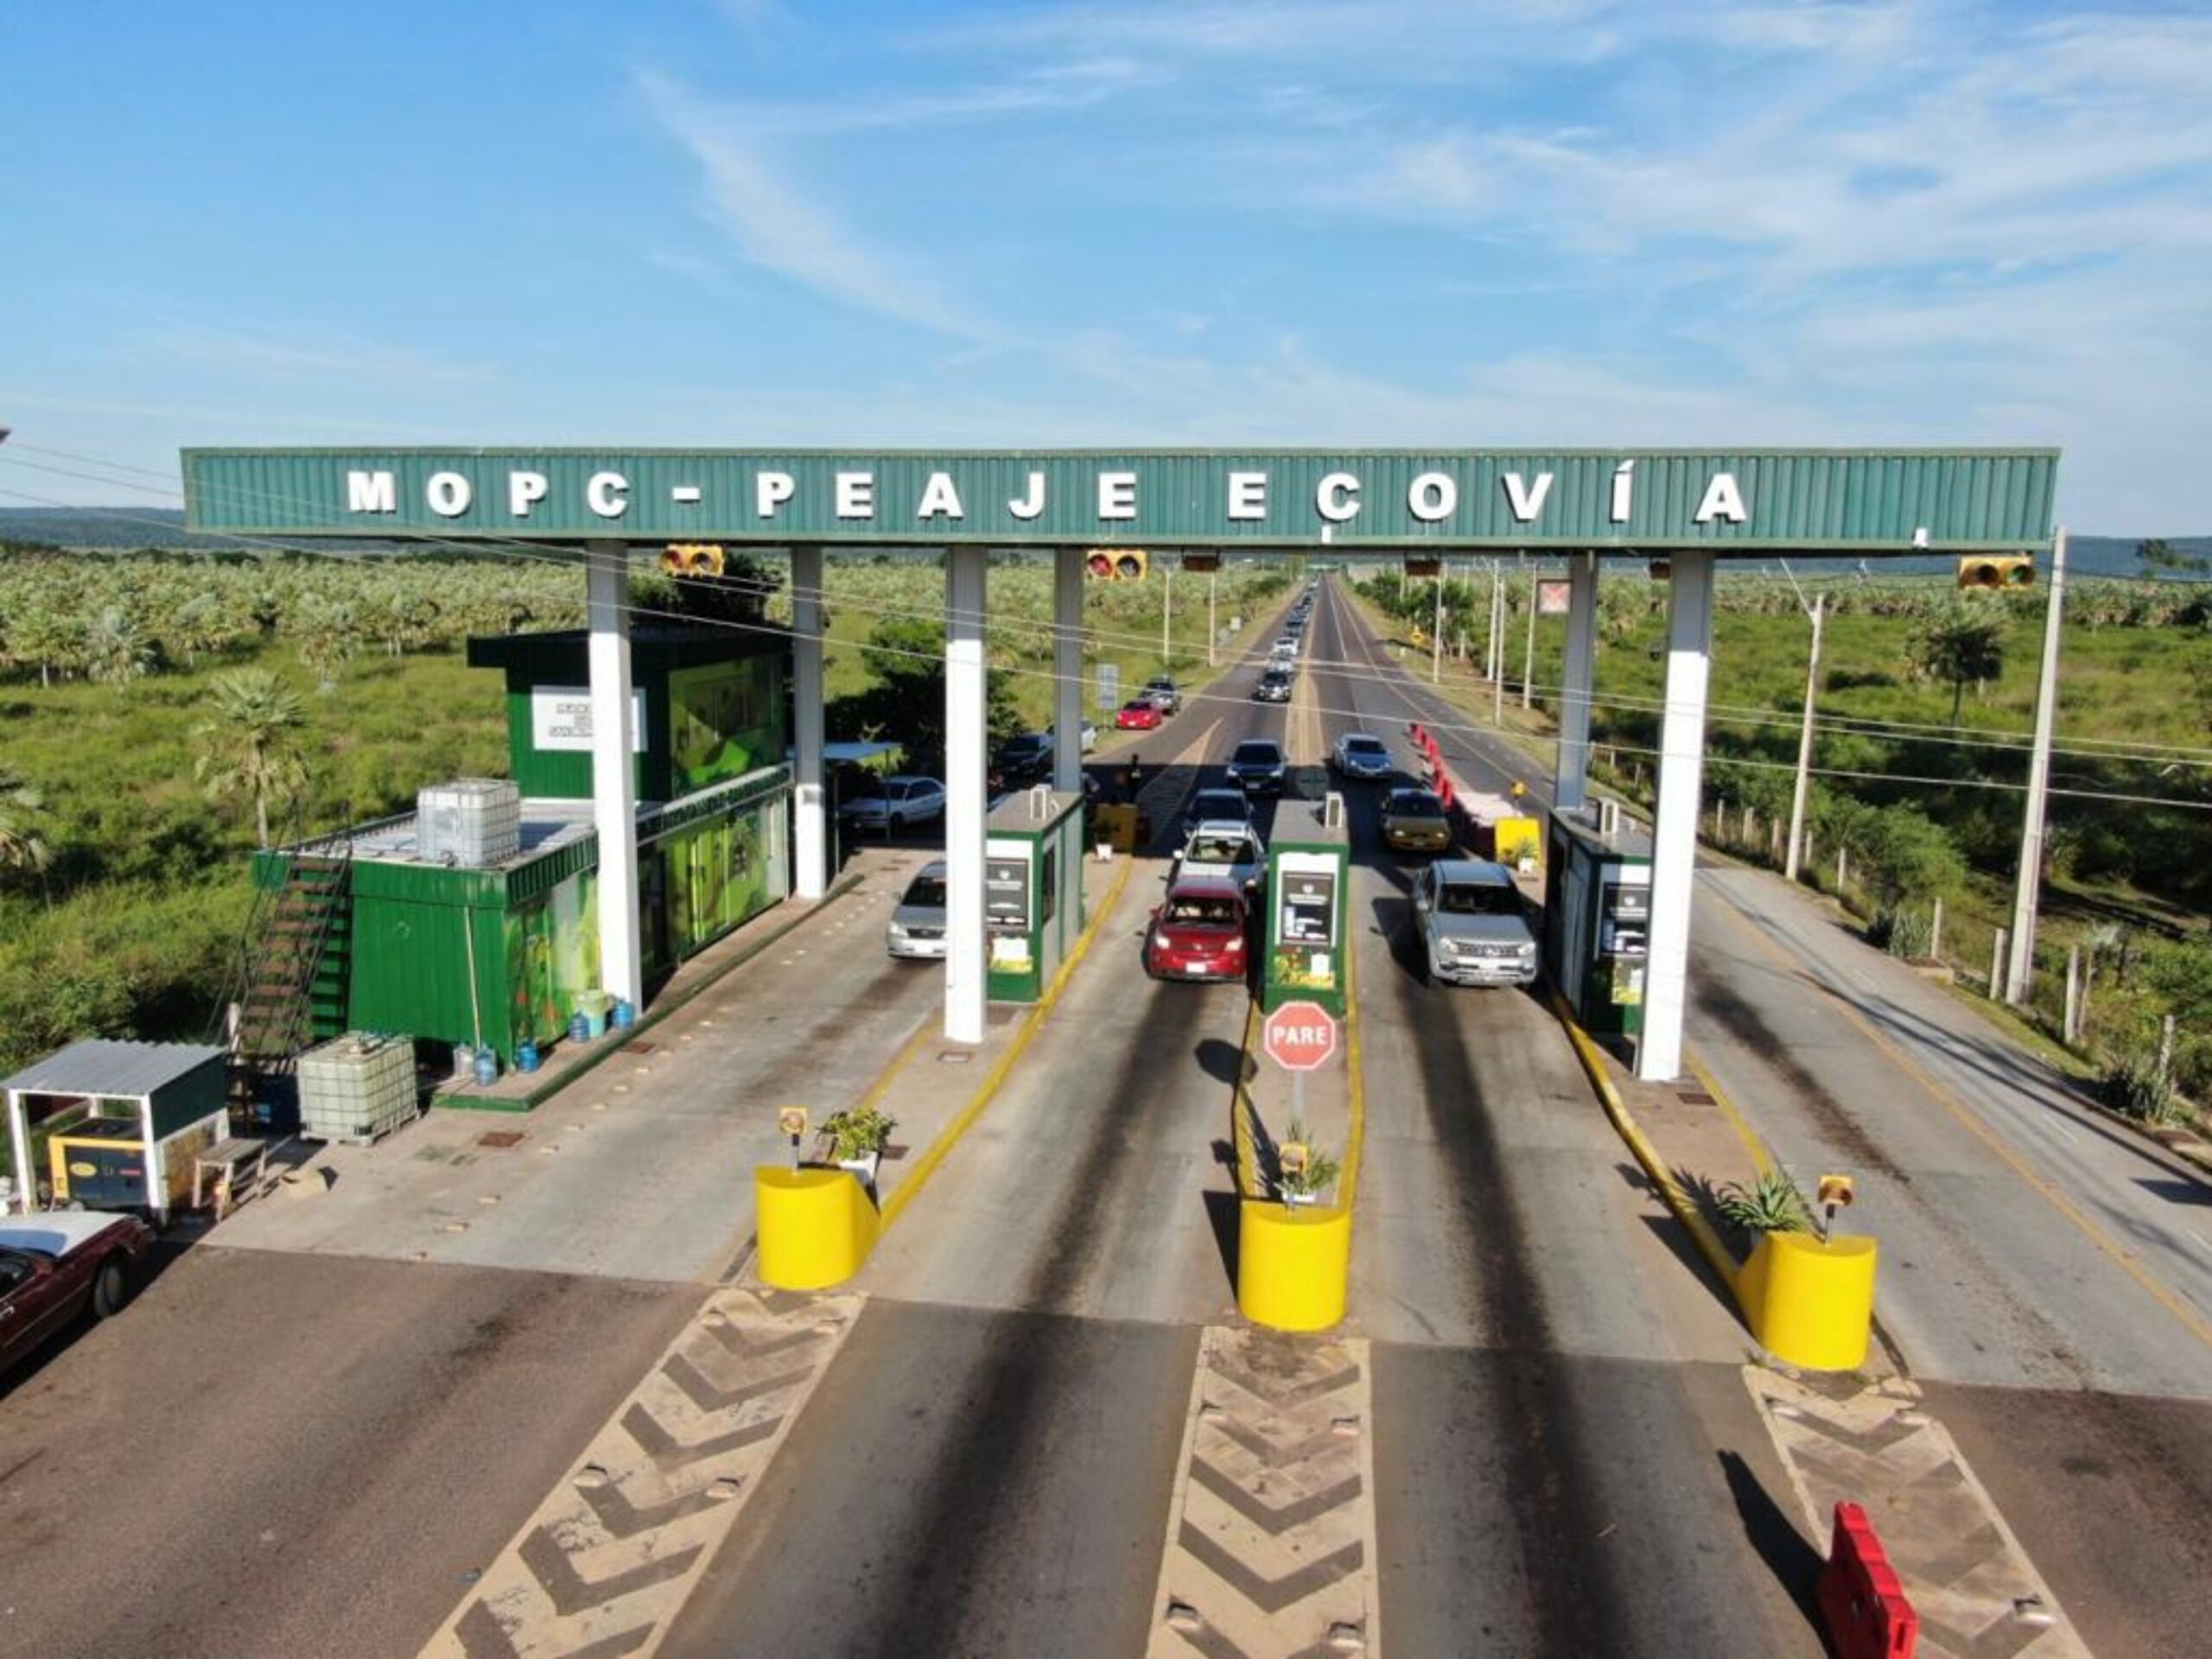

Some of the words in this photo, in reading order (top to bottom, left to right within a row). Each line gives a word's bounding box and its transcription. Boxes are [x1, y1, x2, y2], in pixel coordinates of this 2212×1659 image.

[347, 471, 628, 517] MOPC
[757, 471, 1137, 518] PEAJE
[1228, 459, 1747, 521] ECOVÍA
[1272, 1026, 1328, 1046] PARE
